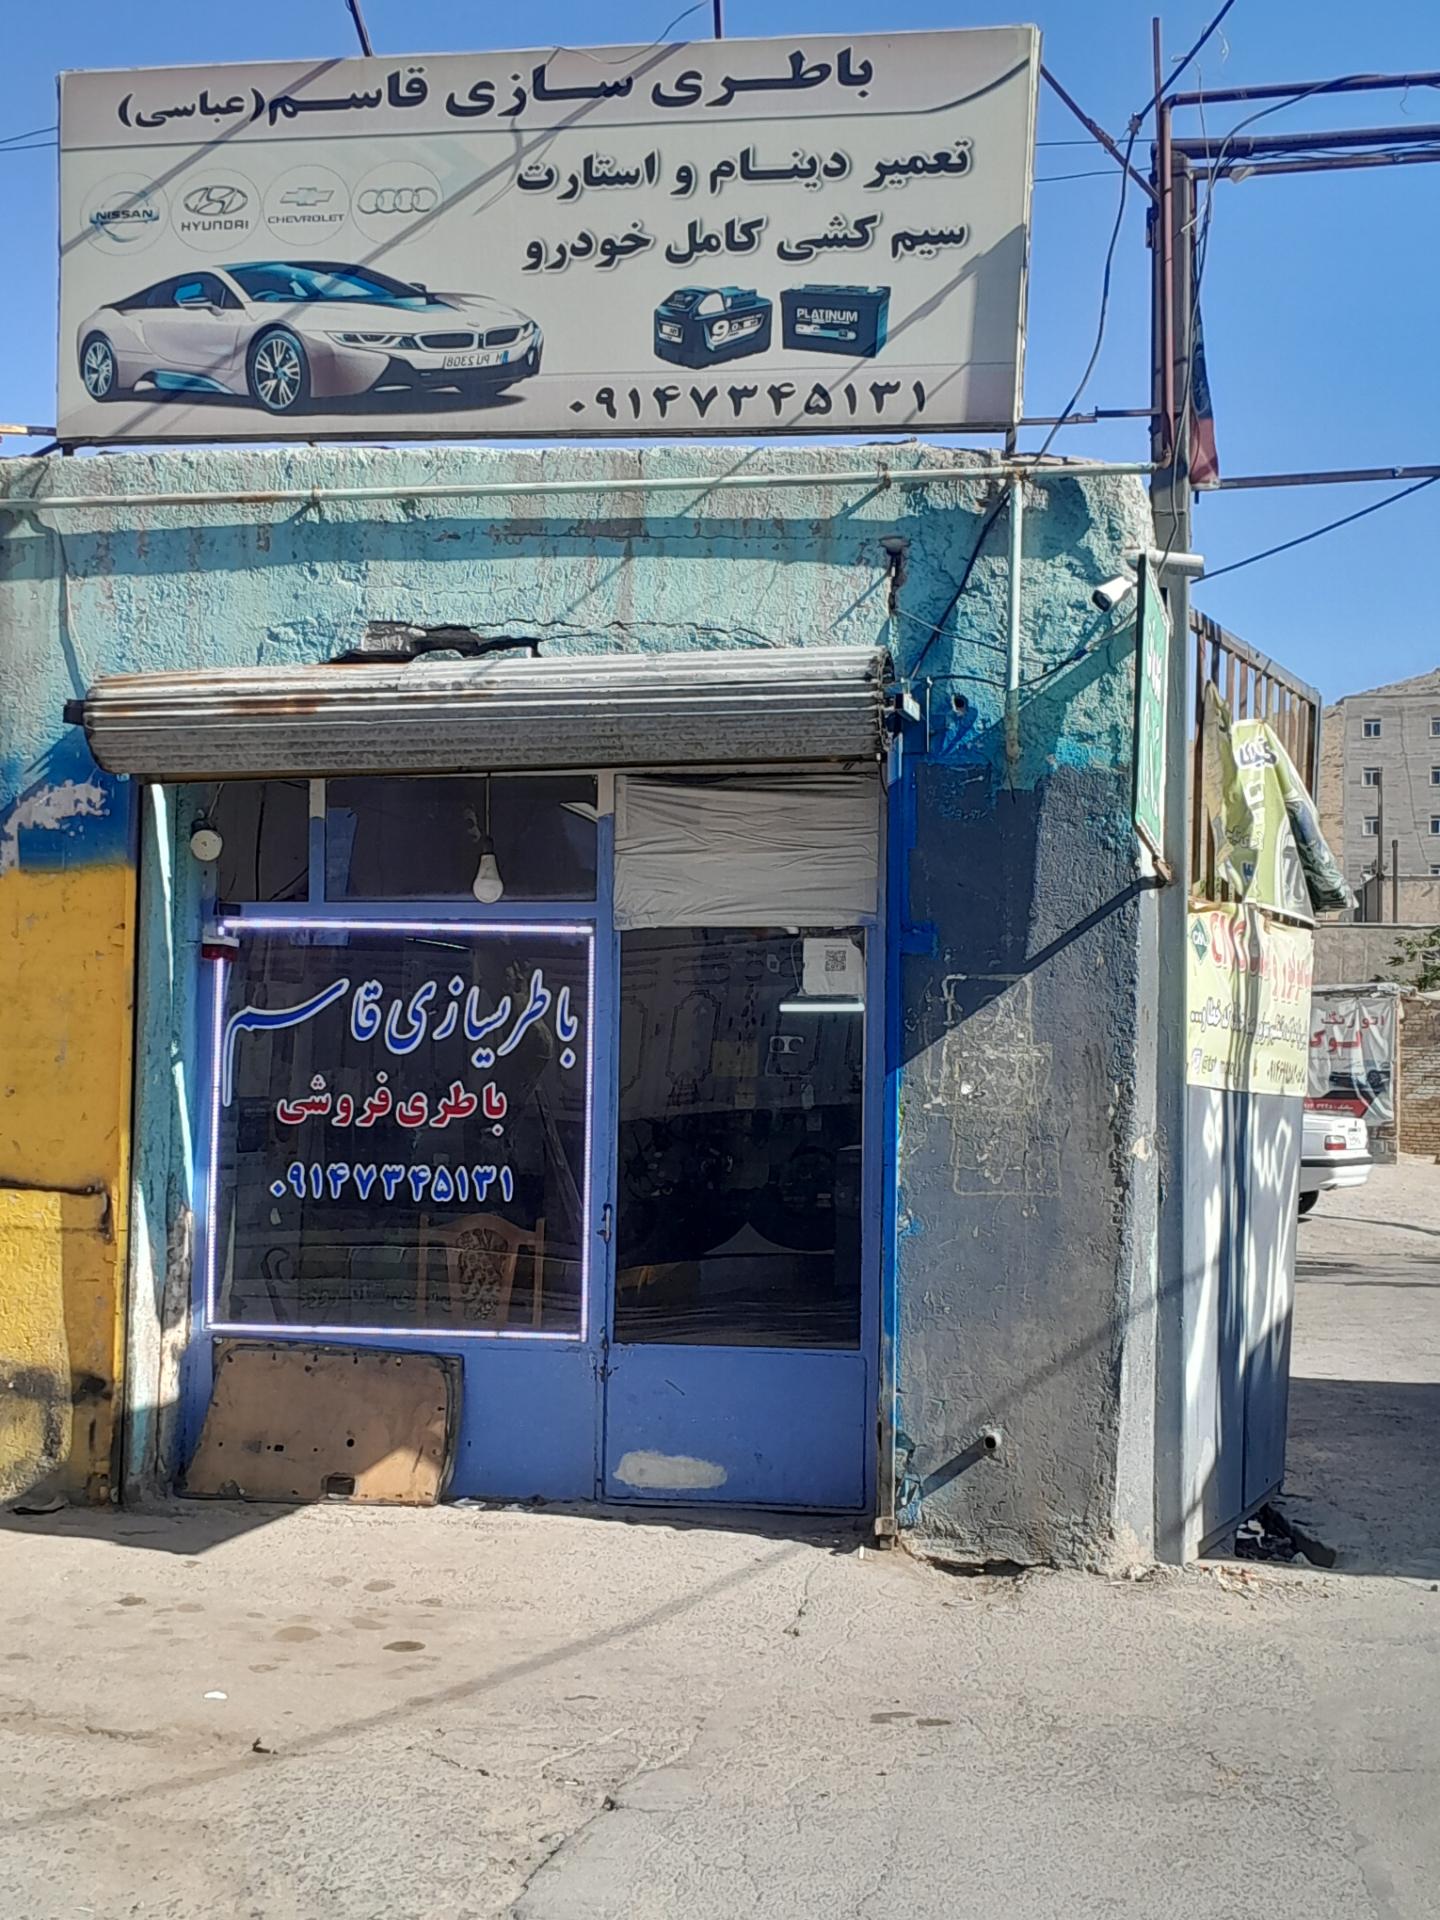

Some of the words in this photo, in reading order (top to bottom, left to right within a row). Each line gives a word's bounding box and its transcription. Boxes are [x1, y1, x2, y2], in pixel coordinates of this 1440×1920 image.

[267, 67, 430, 126] قاسم
[443, 62, 635, 118] سازی
[651, 46, 874, 108] باطری
[516, 149, 657, 200] استارت
[670, 163, 694, 196] و
[709, 147, 851, 194] دینام
[863, 137, 974, 189] تعمیر
[96, 209, 153, 220] NISSAN
[181, 220, 249, 232] HYUNDAI
[267, 213, 345, 225] CHEVROLET
[776, 212, 879, 262] کشی
[521, 219, 654, 272] خودرو
[665, 217, 765, 265] کامل
[890, 221, 968, 259] سیم
[796, 307, 858, 323] PLATINUM
[569, 379, 928, 420] ۰۹۱۴۷۳۴۵۱۳۱
[220, 977, 385, 1107] قاسم
[276, 1071, 392, 1128] فروشی
[396, 1080, 507, 1136] باطری
[269, 1162, 515, 1202] ۰۹۱۴۷۳۴۵۱۳۱
